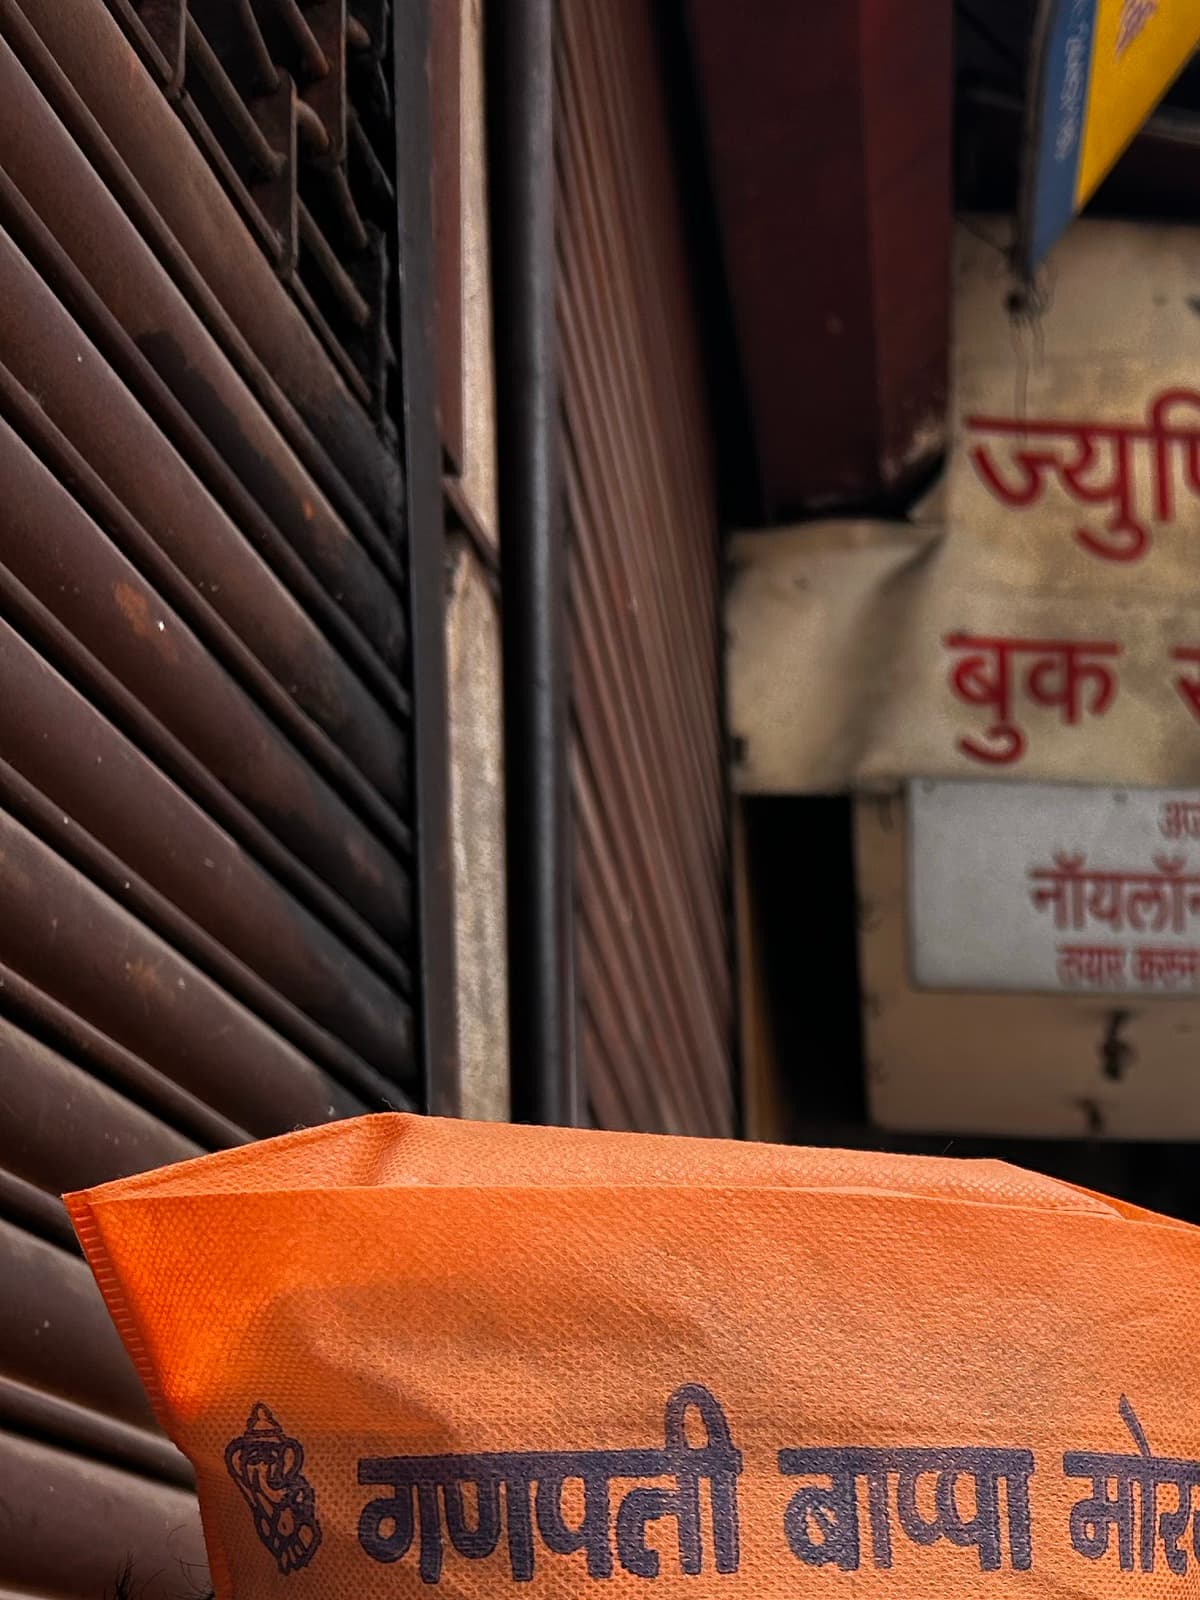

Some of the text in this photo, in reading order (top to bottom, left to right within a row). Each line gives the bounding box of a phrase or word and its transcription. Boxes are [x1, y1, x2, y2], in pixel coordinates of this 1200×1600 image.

[945, 634, 1120, 765] बुक
[357, 1382, 743, 1584] गणपती
[778, 1447, 1033, 1573] बाप्पा
